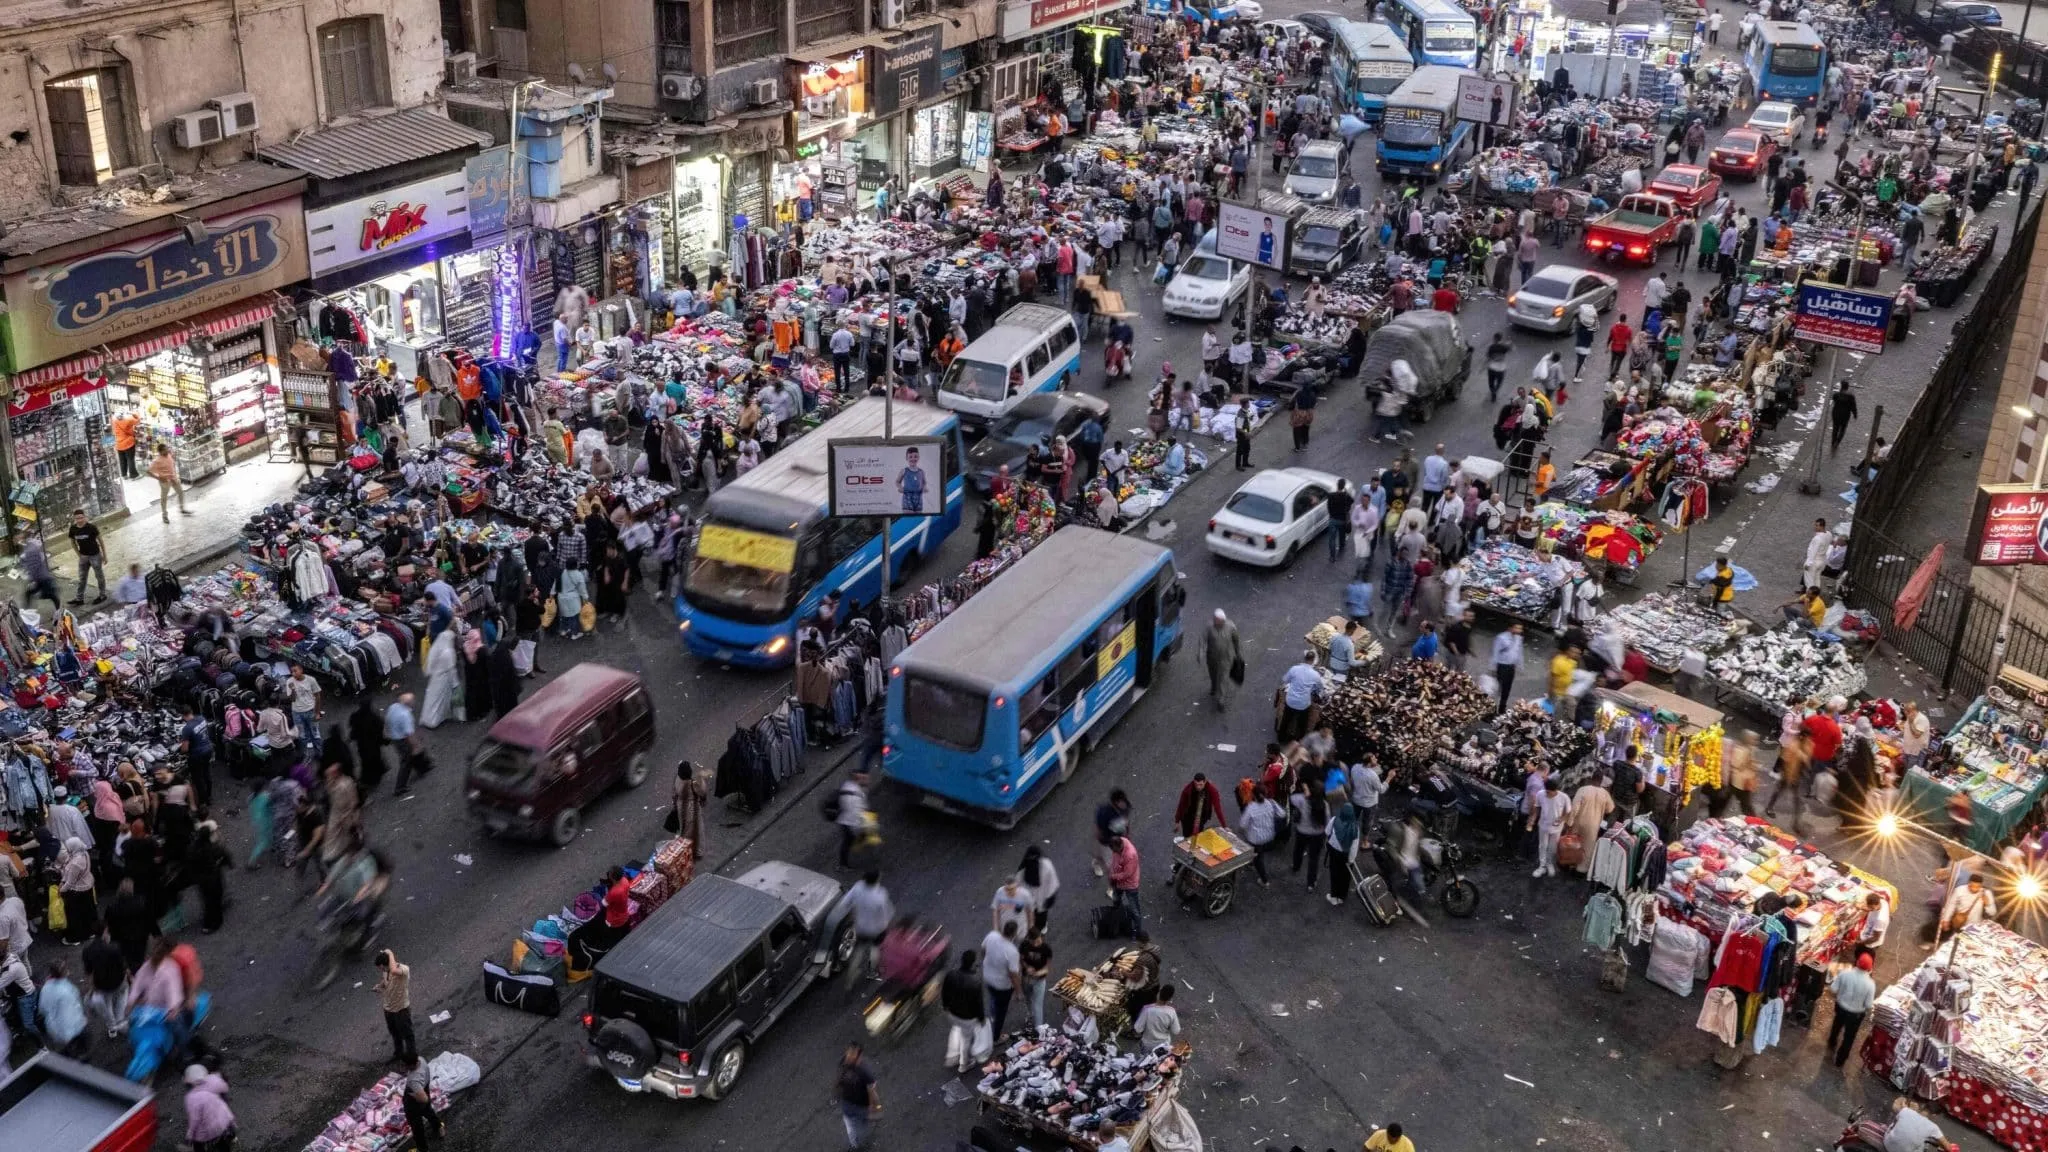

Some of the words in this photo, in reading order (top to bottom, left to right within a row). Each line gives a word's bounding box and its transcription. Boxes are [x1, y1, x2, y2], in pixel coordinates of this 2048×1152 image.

[900, 75, 918, 100] BTC
[1225, 225, 1249, 237] Ots
[1807, 296, 1882, 317] تساهيل
[846, 475, 884, 486] Ots
